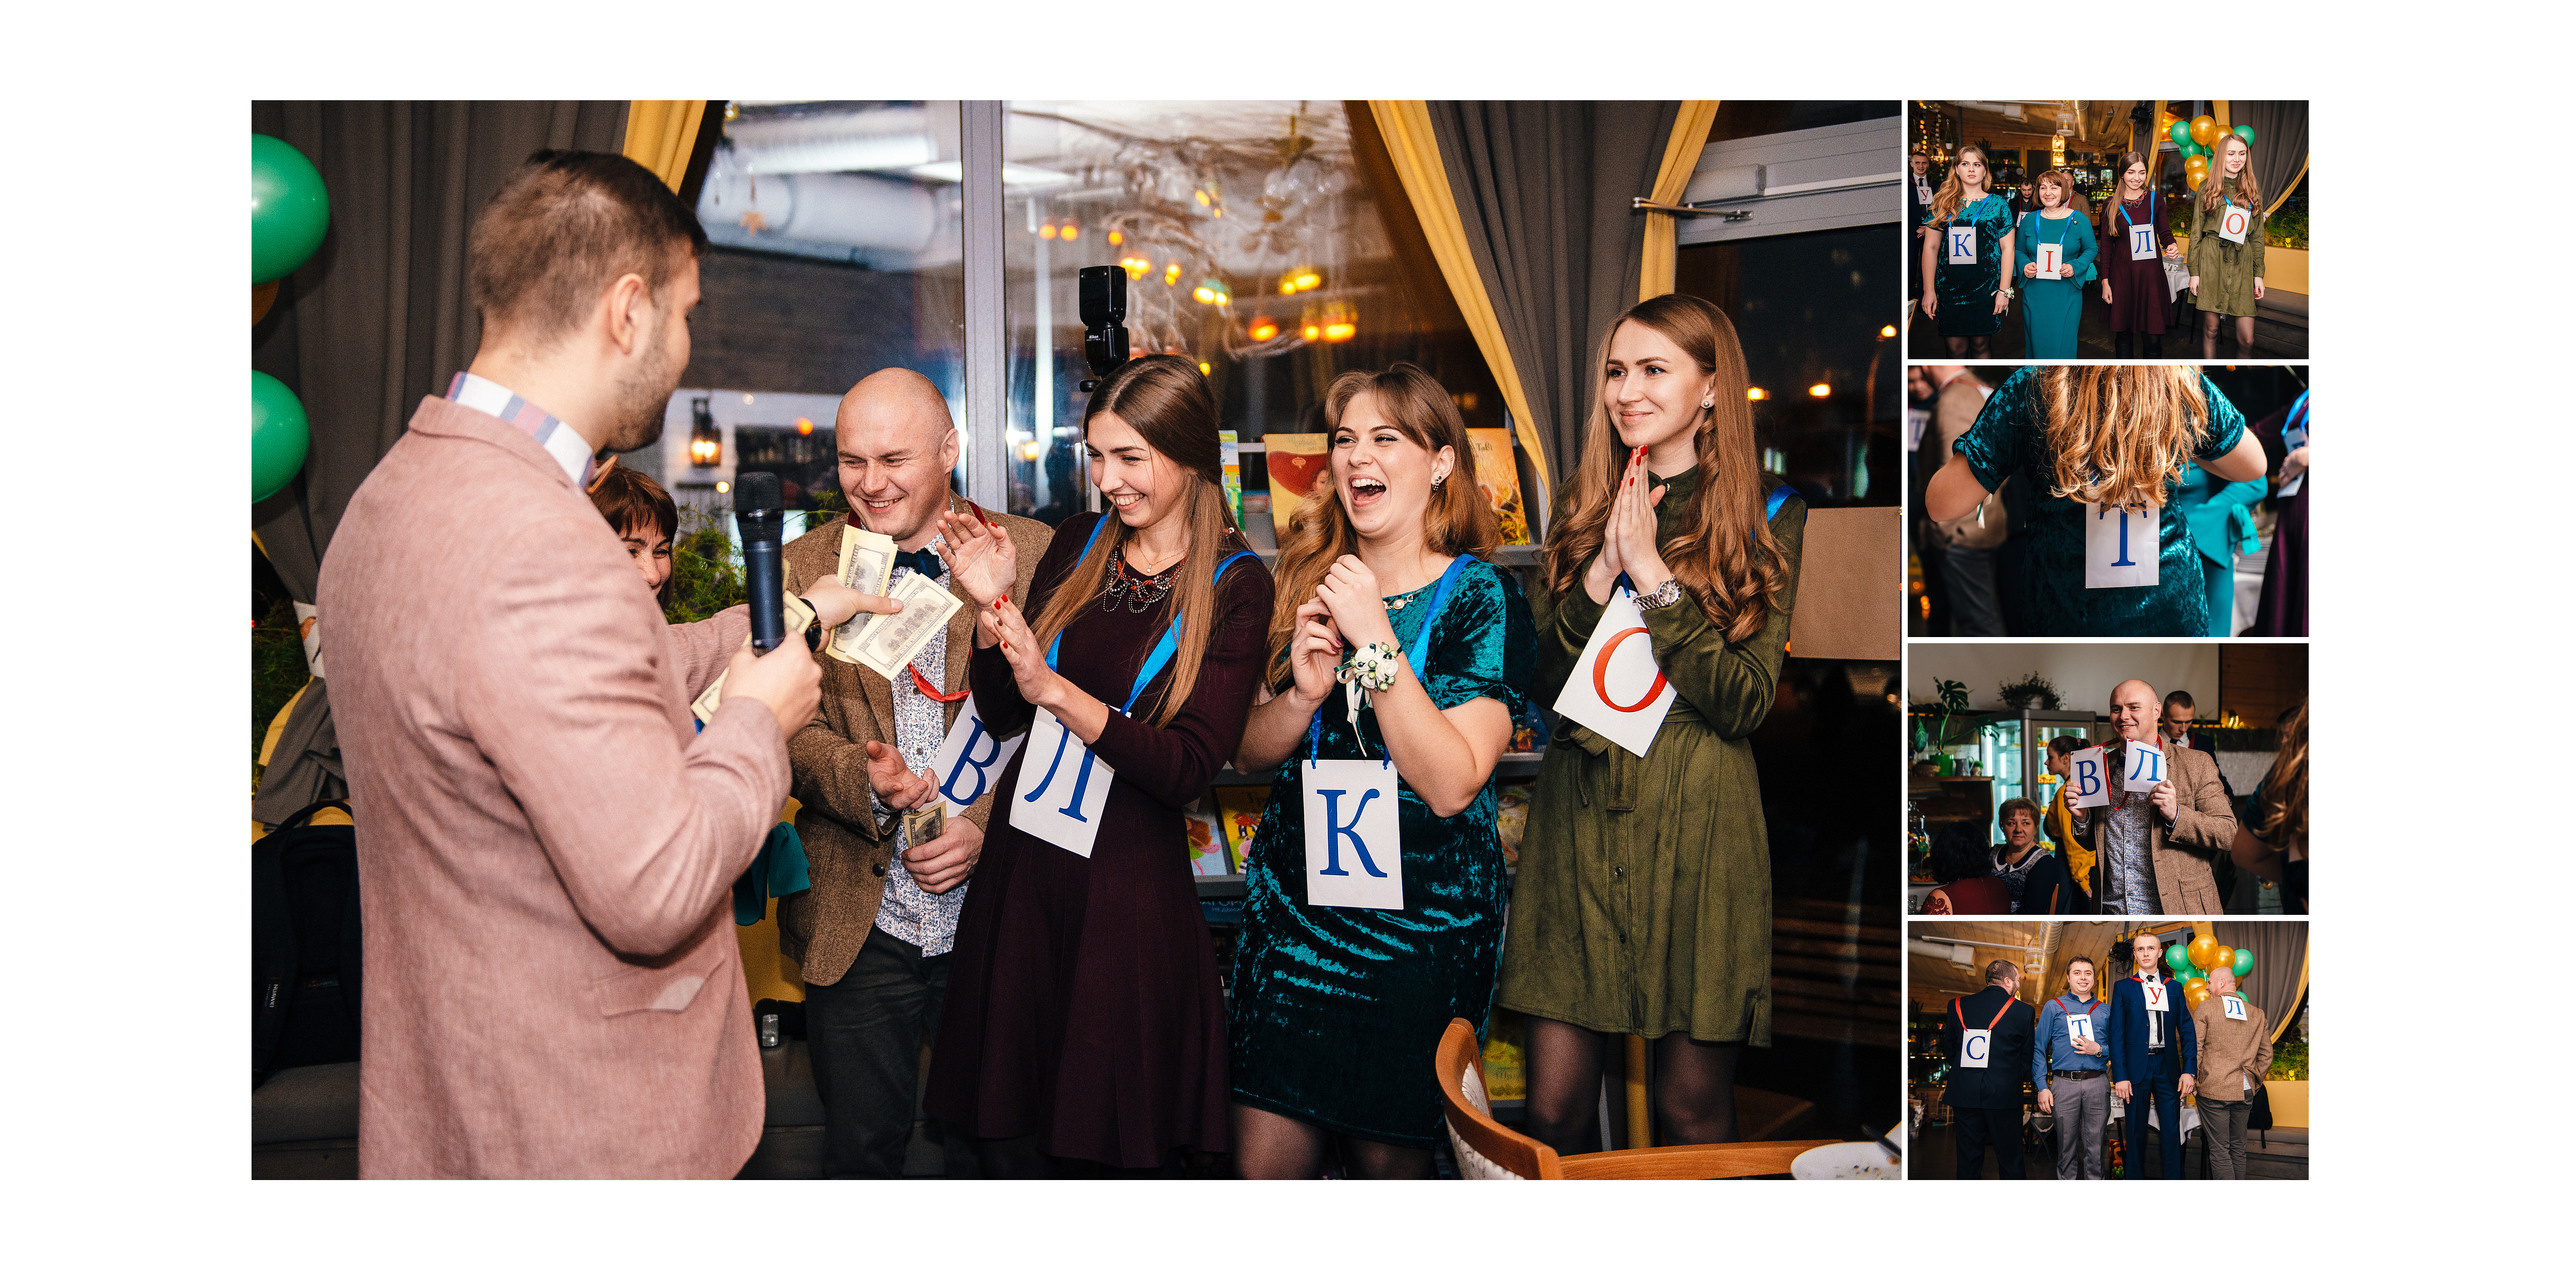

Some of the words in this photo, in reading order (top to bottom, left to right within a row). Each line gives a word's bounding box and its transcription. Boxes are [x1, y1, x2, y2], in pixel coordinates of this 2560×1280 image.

[1952, 233, 1973, 257] К
[2135, 230, 2153, 253] Л
[2129, 747, 2162, 782] Л
[2076, 759, 2101, 797] В
[1316, 788, 1388, 878] К
[2148, 986, 2163, 1005] У
[2228, 1000, 2243, 1016] Л
